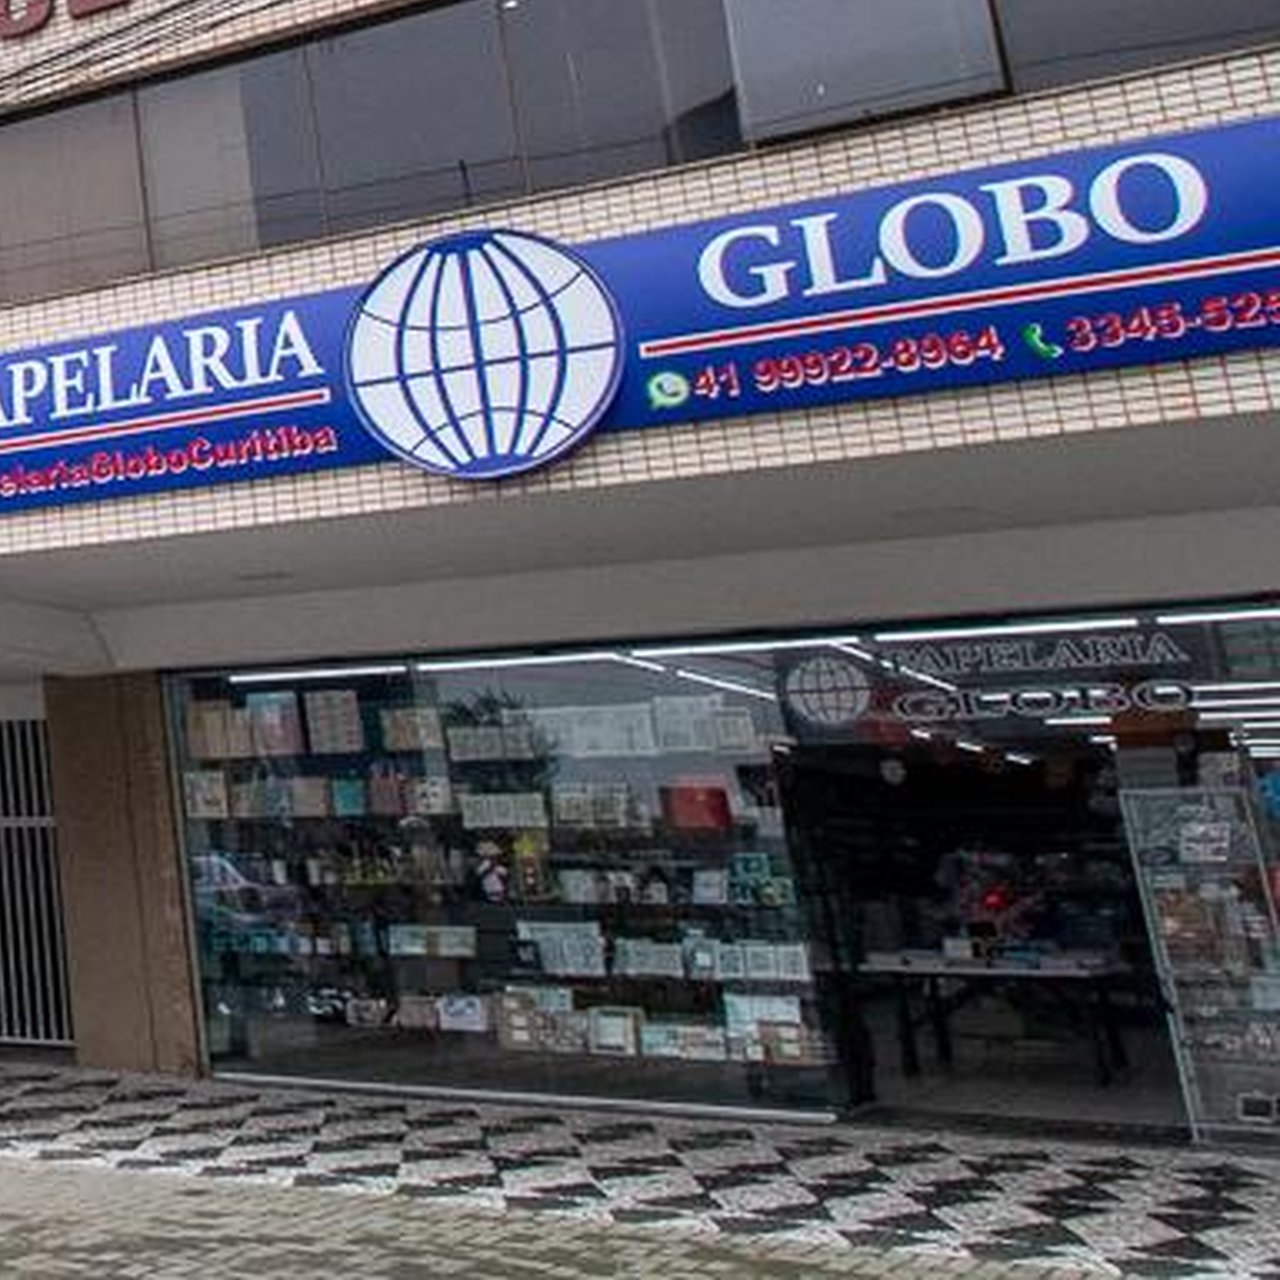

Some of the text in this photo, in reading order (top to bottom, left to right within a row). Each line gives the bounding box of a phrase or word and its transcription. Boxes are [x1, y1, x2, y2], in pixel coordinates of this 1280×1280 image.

[697, 152, 1208, 308] GLOBO
[694, 363, 741, 399] 41
[753, 324, 1006, 393] 99922-8964
[892, 679, 1194, 722] GLOBO
